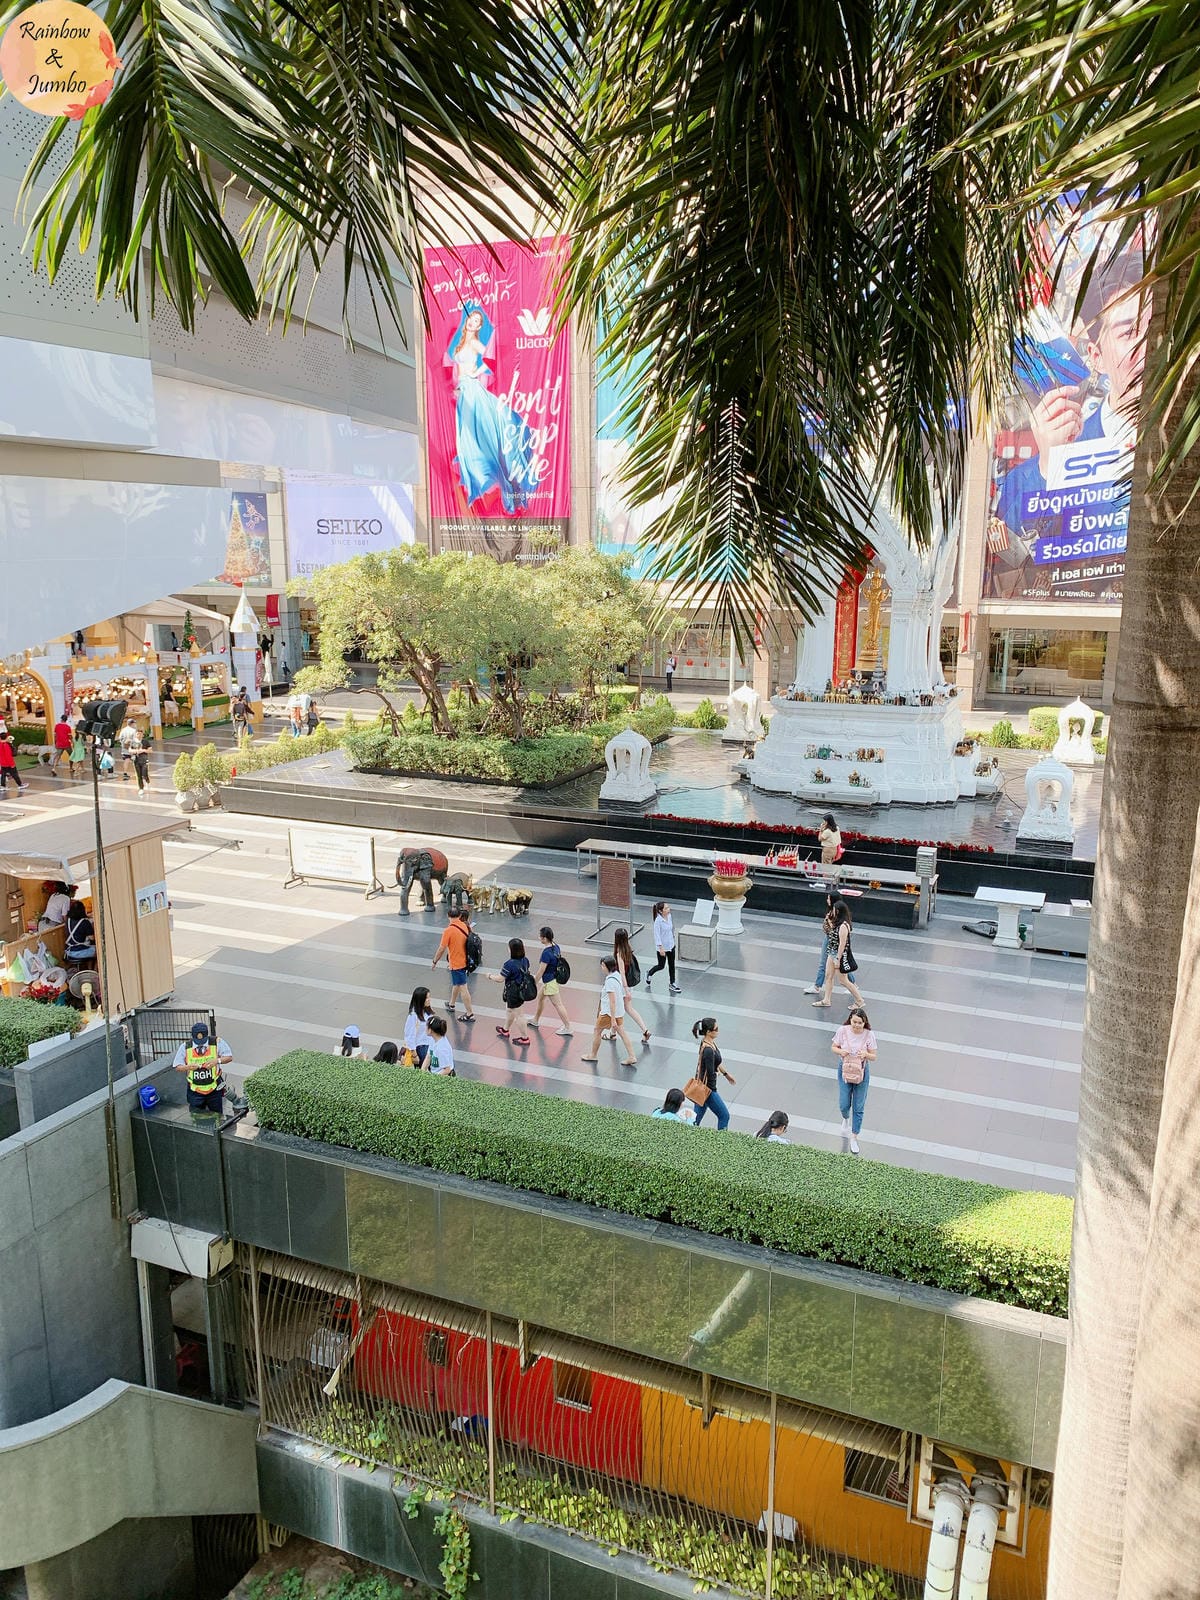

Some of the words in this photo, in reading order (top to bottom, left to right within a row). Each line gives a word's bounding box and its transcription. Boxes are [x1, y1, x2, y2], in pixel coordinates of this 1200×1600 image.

[516, 336, 552, 350] Wacoa
[497, 371, 562, 420] don't
[502, 414, 558, 455] stop
[1064, 449, 1120, 481] SF
[316, 518, 383, 535] SEIKO
[193, 1069, 212, 1080] RGH
